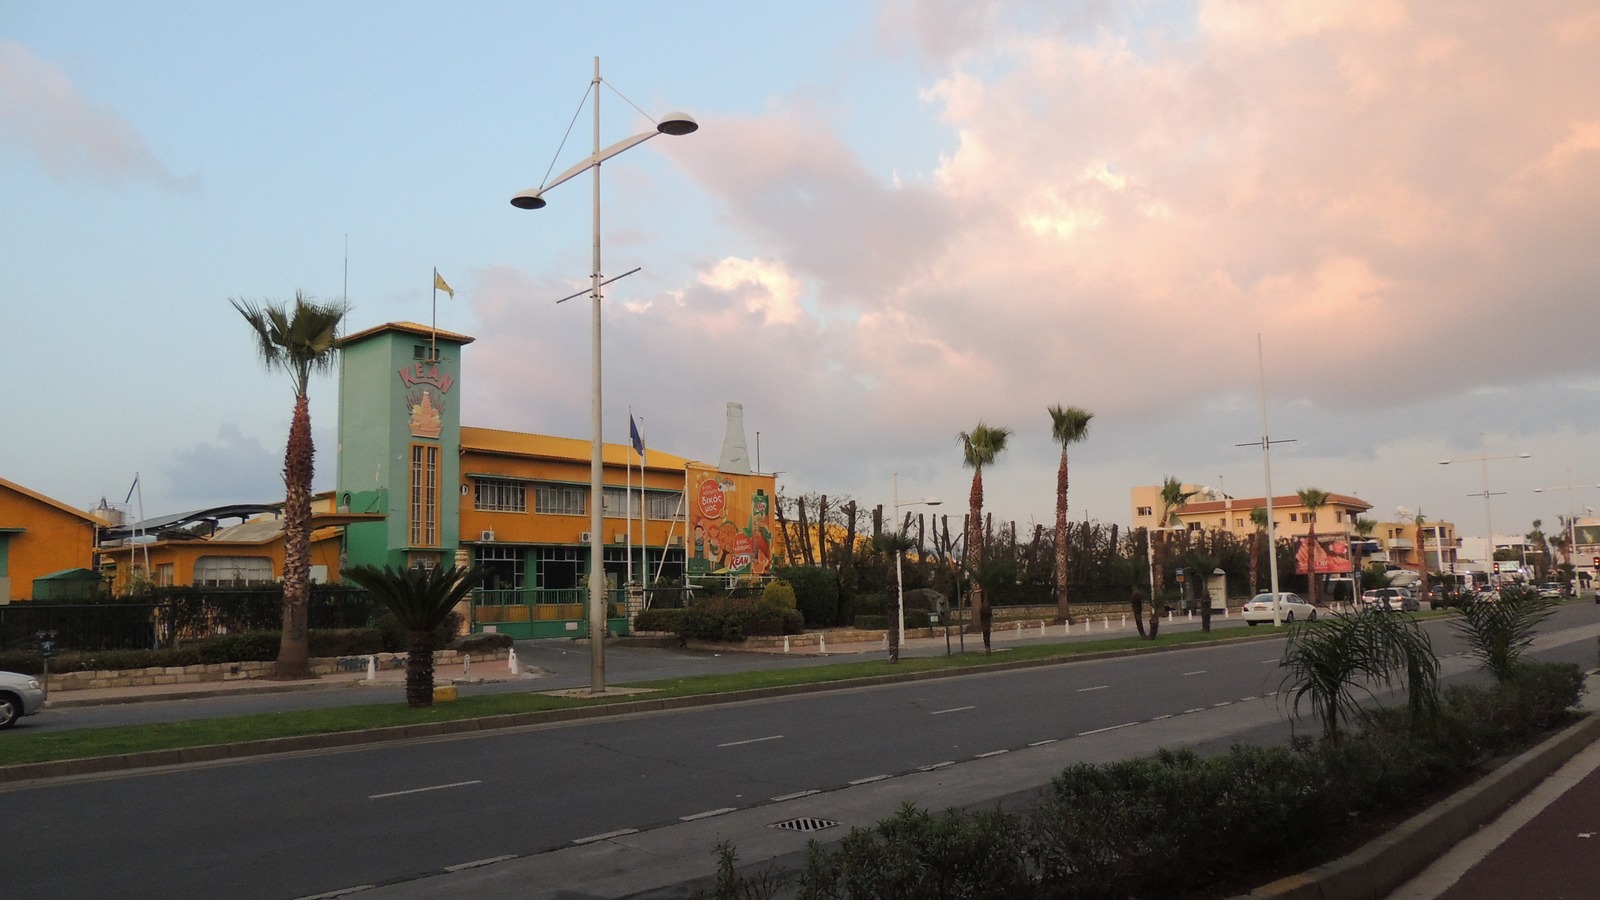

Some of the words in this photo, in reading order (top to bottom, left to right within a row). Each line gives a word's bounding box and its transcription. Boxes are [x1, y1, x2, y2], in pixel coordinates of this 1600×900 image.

[398, 362, 454, 394] KEAN
[702, 494, 723, 505] δικός
[705, 504, 717, 514] μας
[729, 555, 748, 569] KEAN
